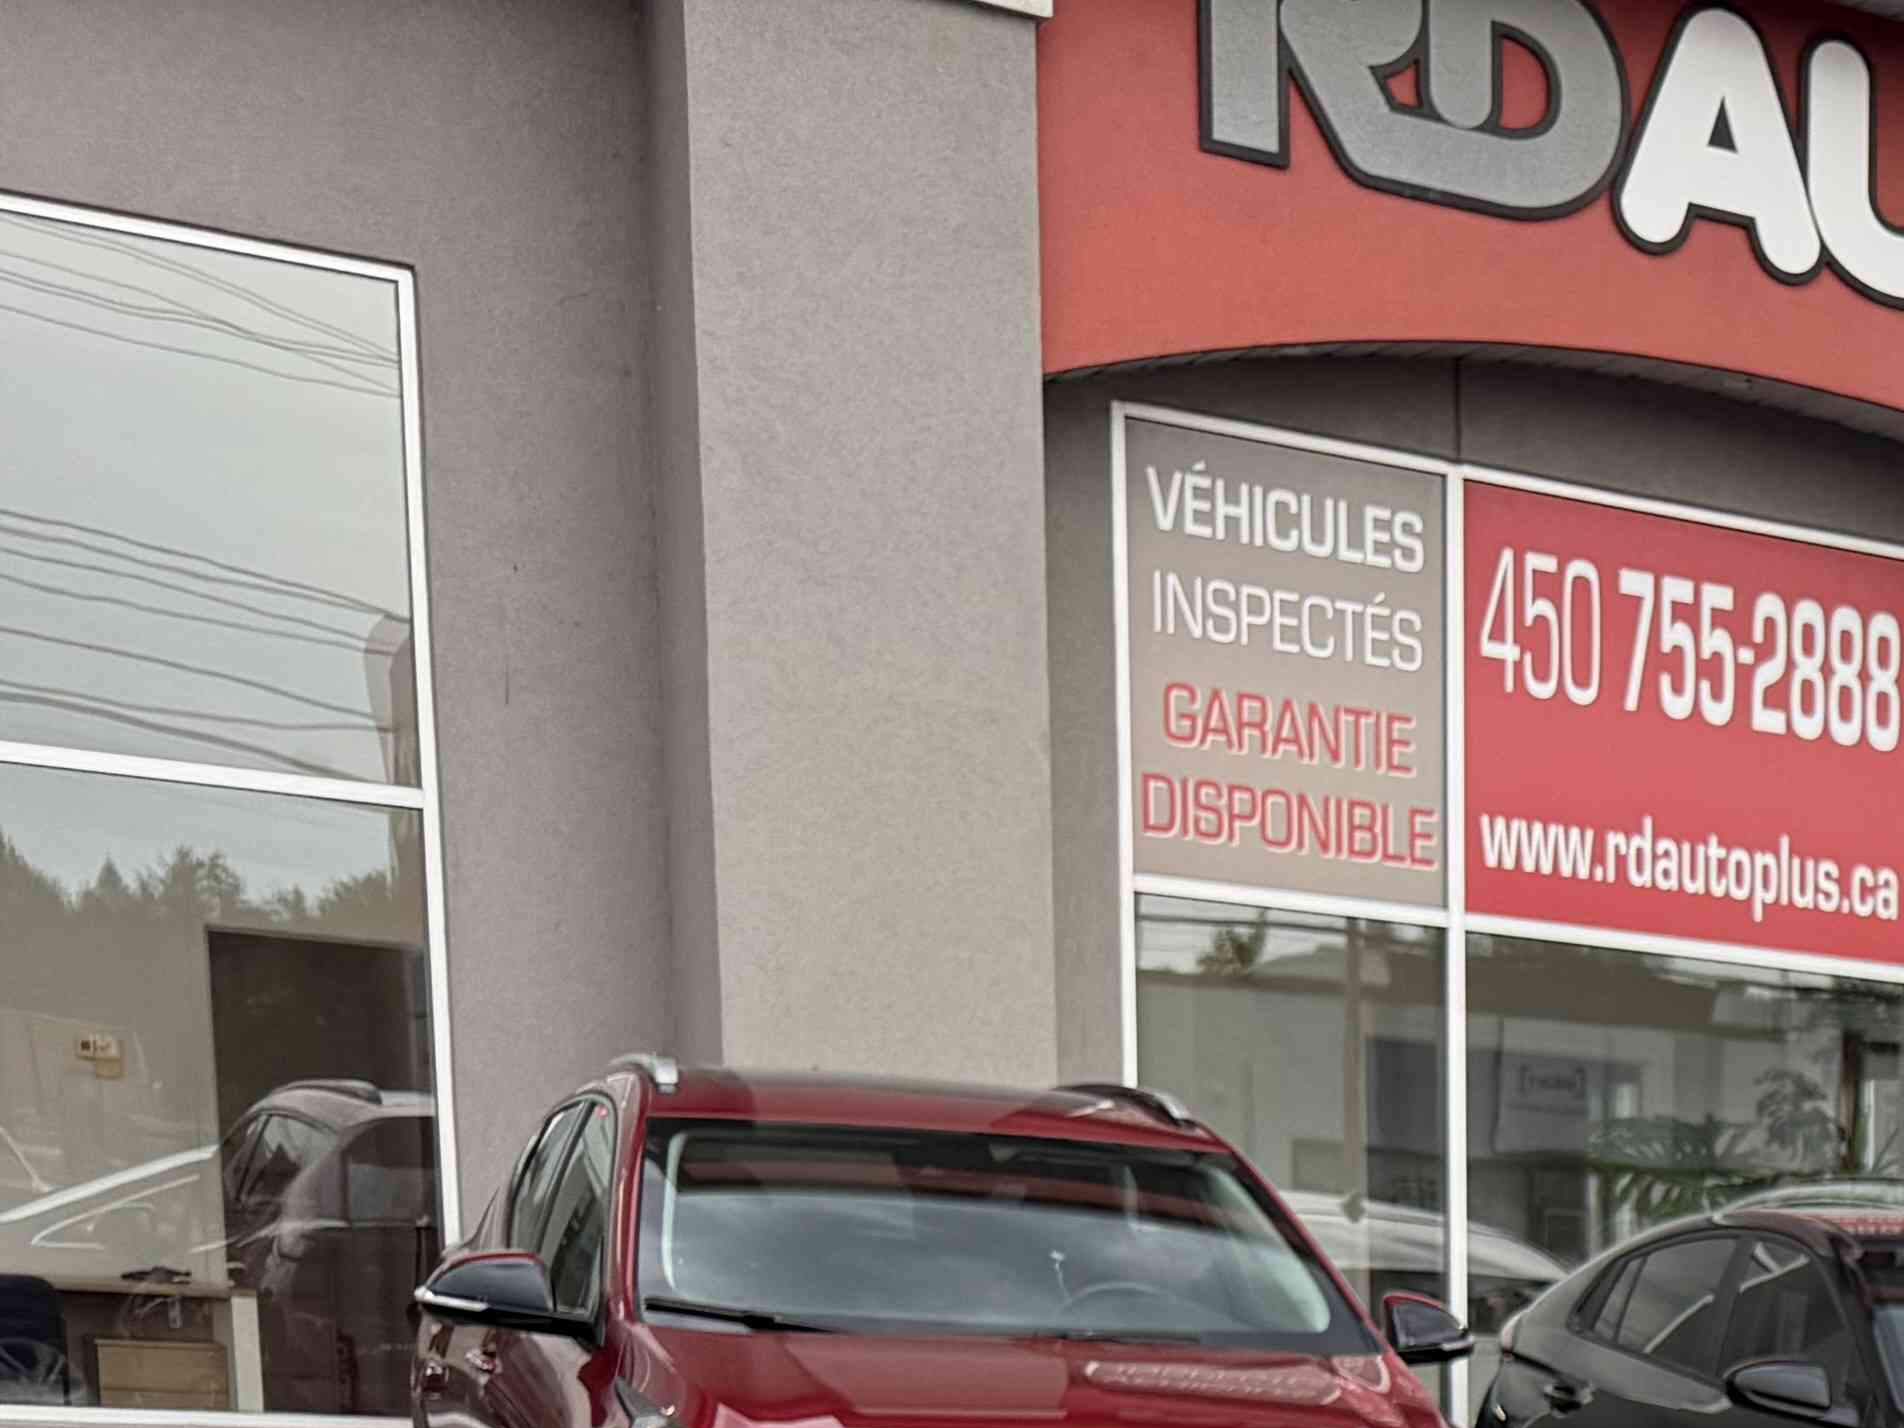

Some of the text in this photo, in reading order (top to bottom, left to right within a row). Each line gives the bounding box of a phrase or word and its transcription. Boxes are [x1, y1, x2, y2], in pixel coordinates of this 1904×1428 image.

[1200, 0, 1630, 222] RD
[1145, 460, 1426, 574] VÉHICULES
[1151, 569, 1424, 673] INSPECTÉS
[1479, 546, 1901, 753] 450 755-2888
[1162, 681, 1418, 778] GARANTIE
[1139, 770, 1440, 872] DISPONIBLE
[1479, 813, 1900, 924] www.rdautoplus.ca
